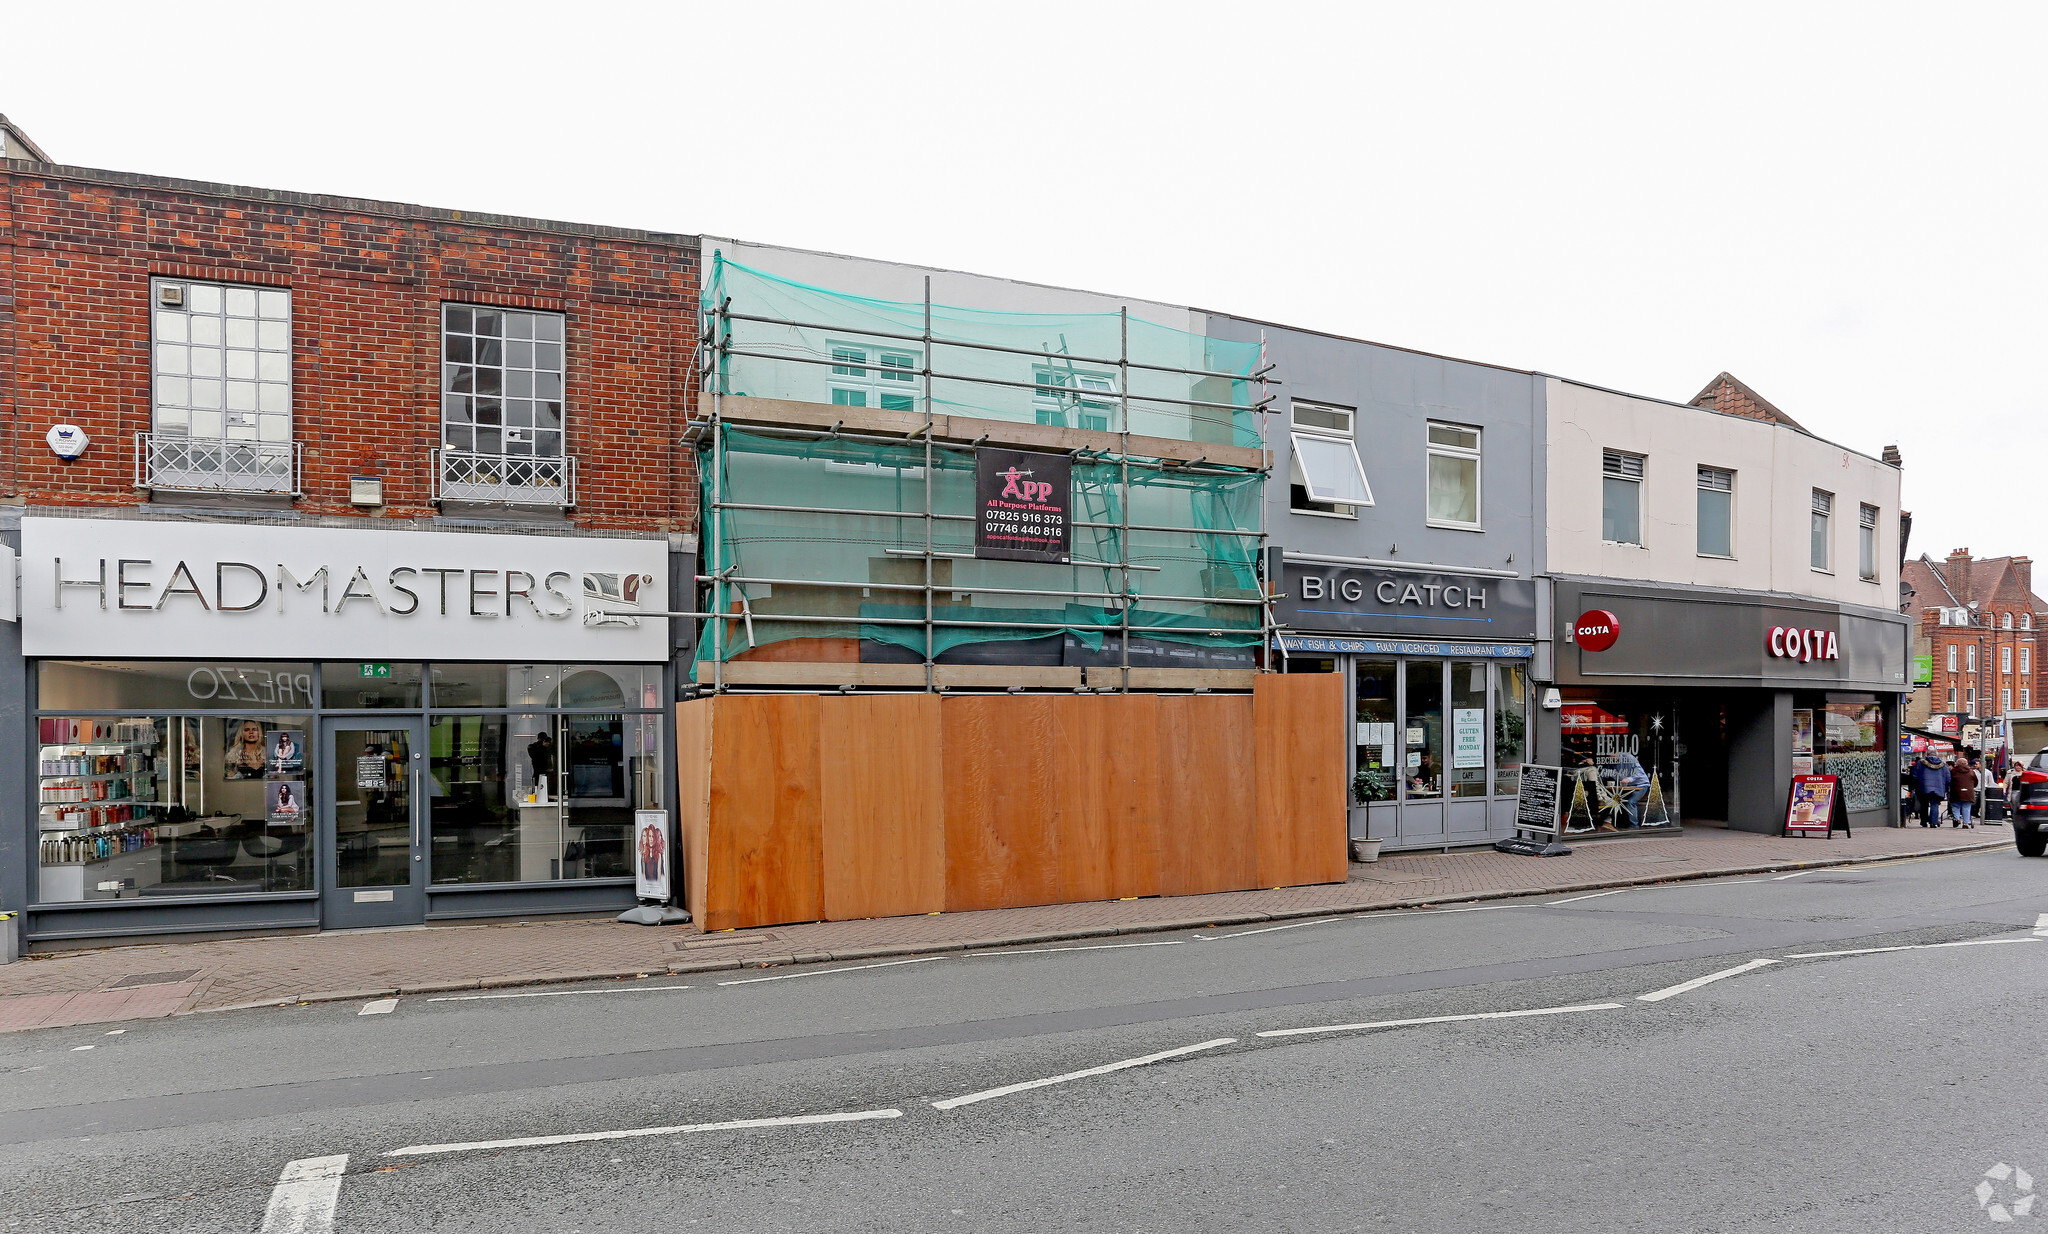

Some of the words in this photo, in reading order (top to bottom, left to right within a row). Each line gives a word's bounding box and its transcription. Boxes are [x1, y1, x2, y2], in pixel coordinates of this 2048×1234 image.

[1001, 467, 1053, 502] APP
[987, 499, 998, 507] All
[999, 501, 1027, 510] Purpose
[1028, 503, 1062, 512] Platforms
[986, 510, 1020, 521] 07825
[1022, 514, 1041, 523] 916
[1043, 515, 1063, 525] 373
[985, 522, 1018, 533] 07746
[1020, 525, 1041, 535] 440
[1043, 527, 1062, 537] 816
[53, 556, 574, 618] HEADMASTERS
[1302, 576, 1363, 601] BIG
[1376, 581, 1486, 609] CATCH
[1578, 625, 1610, 636] COSTA
[1307, 640, 1326, 650] FISH
[1329, 640, 1337, 650] &
[1340, 641, 1365, 651] CHIPS
[1376, 642, 1398, 653] FULLY
[1401, 643, 1440, 654] LICENCED
[1450, 645, 1496, 656] RESTAURANT
[1502, 646, 1521, 656] CAFE
[1768, 626, 1839, 663] COSTA
[1596, 734, 1639, 755] HELLO
[1597, 765, 1617, 777] Come
